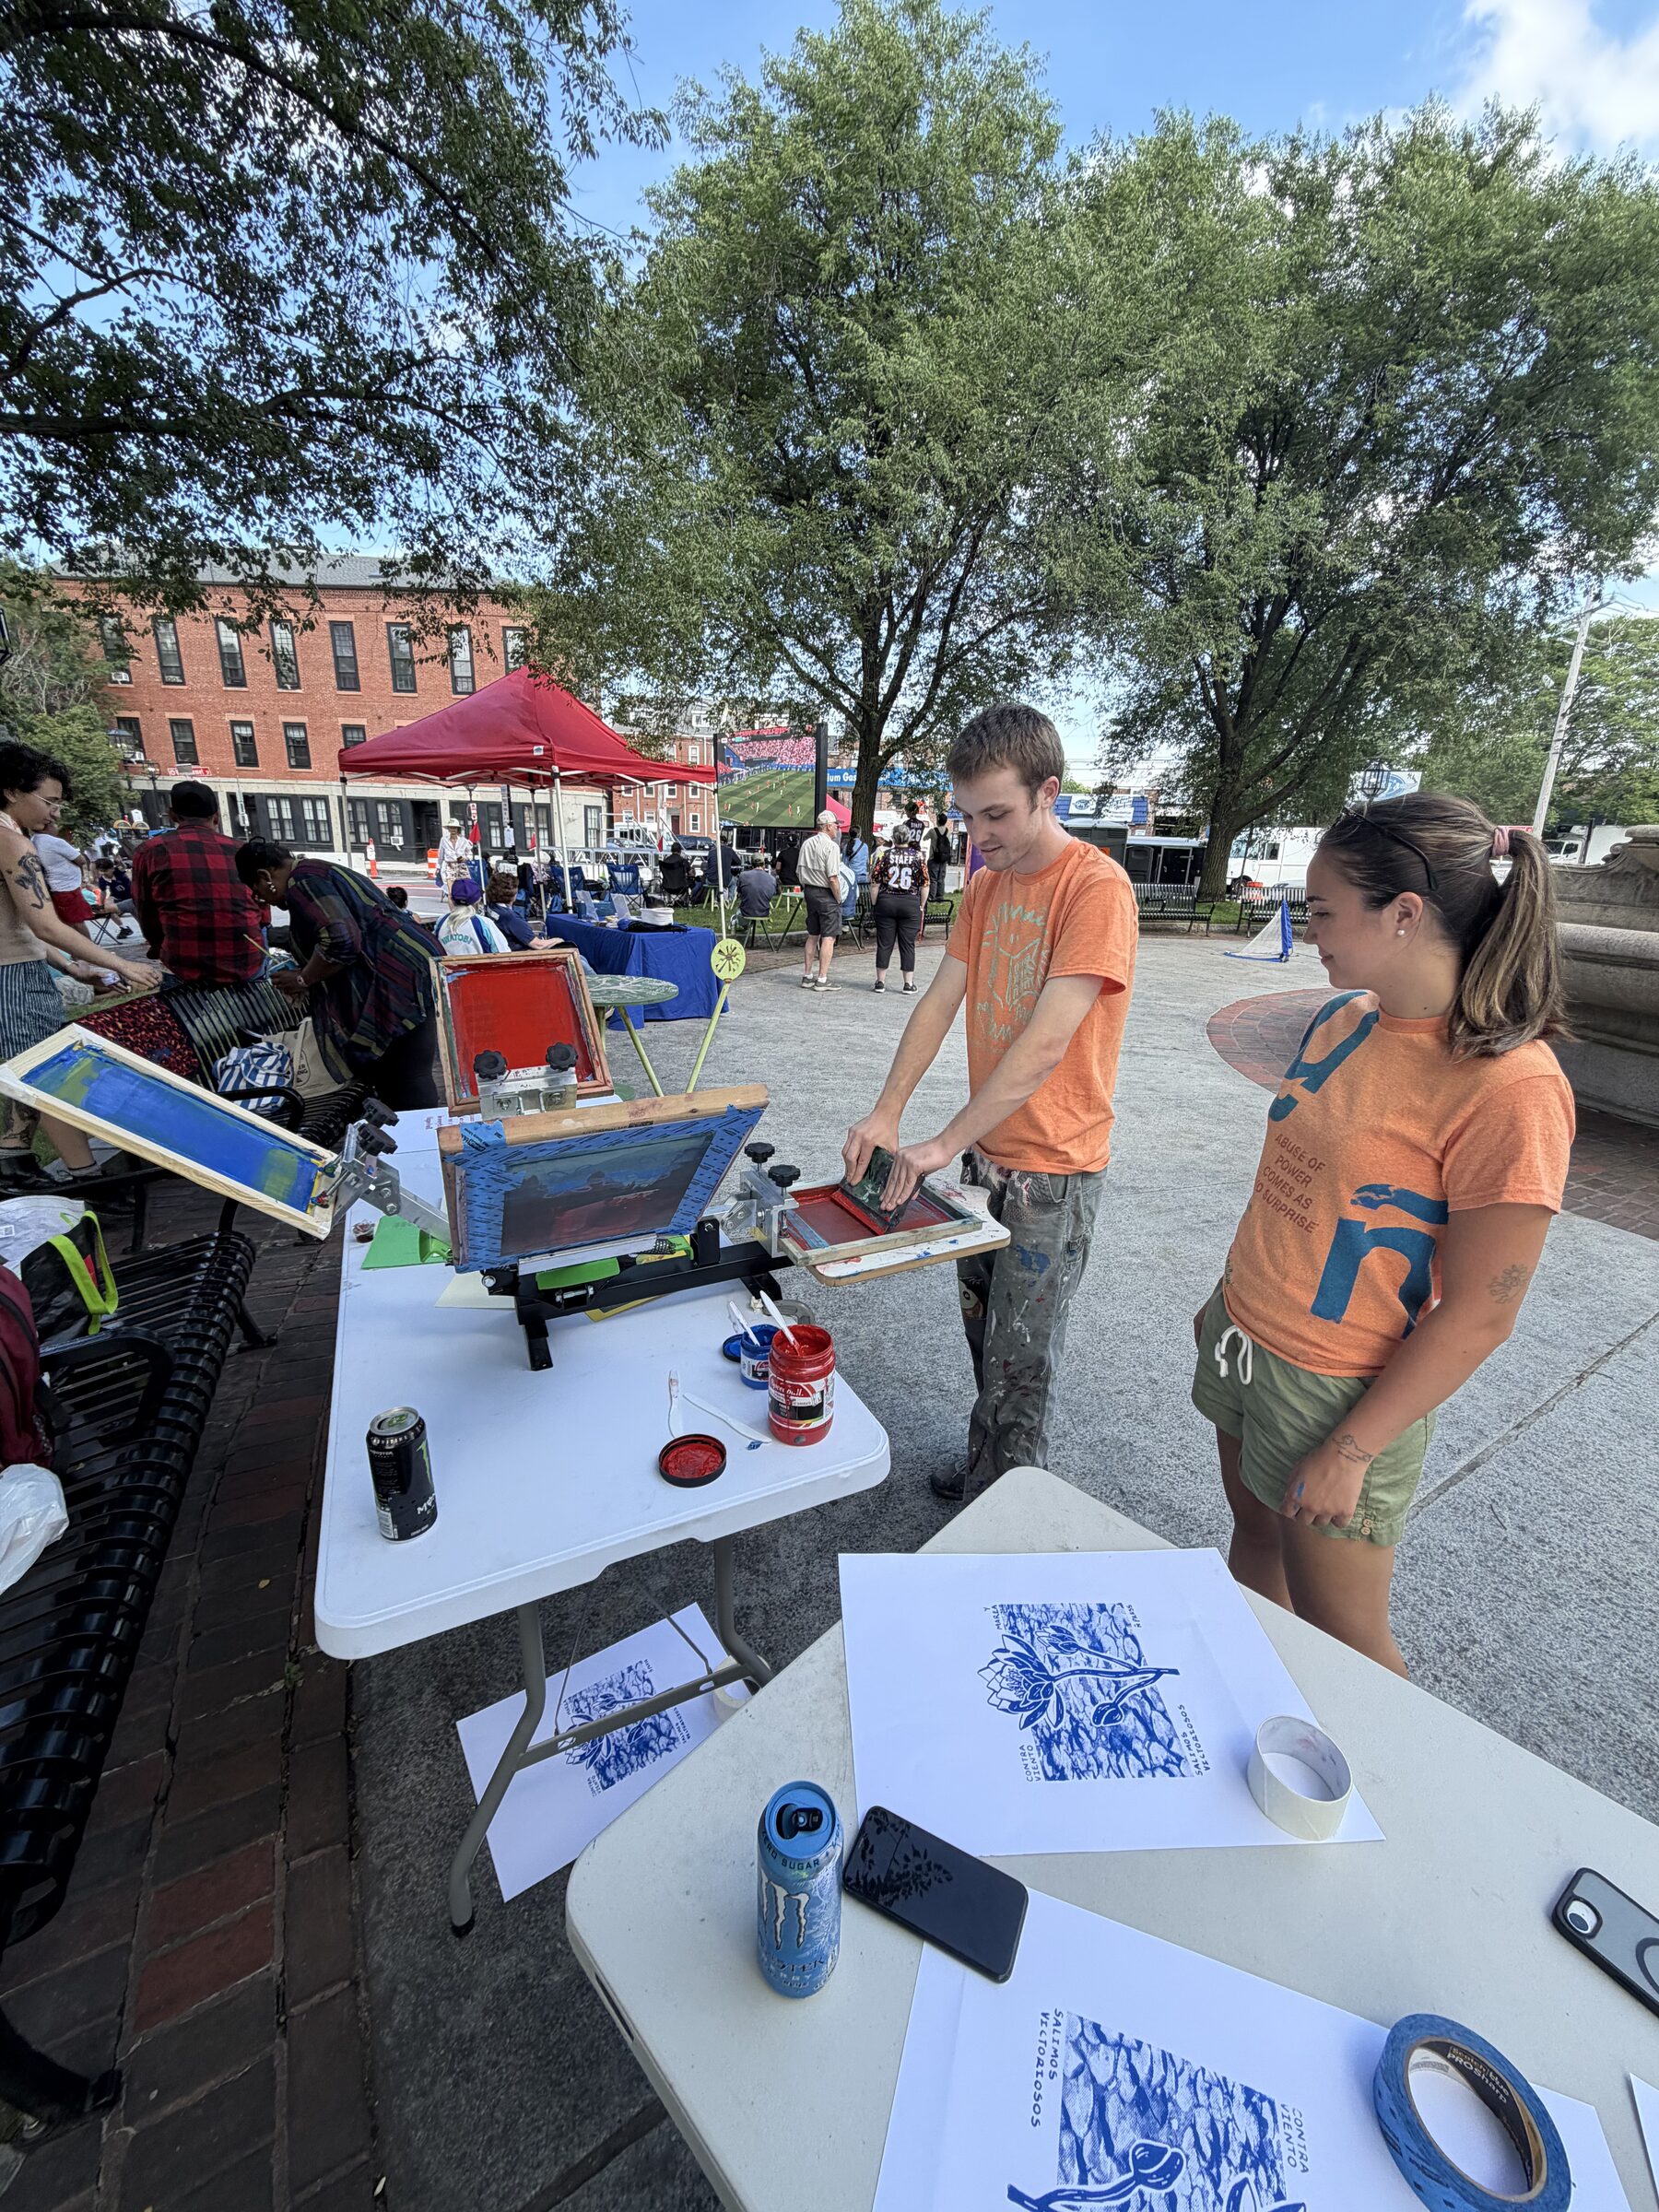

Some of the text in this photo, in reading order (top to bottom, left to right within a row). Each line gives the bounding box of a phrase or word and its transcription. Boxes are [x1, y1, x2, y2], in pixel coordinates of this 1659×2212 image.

[910, 830, 922, 841] 26
[888, 865, 912, 890] 26
[889, 853, 914, 865] STAFF
[1275, 1134, 1325, 1172] ABUSE OF
[1275, 1155, 1312, 1188] POWER
[1263, 1166, 1312, 1209] COMES AS
[1262, 1188, 1319, 1234] SURPRISE
[991, 1604, 1003, 1630] MAREA
[1177, 1704, 1210, 1771] VICTORIOSOS
[1181, 1732, 1203, 1777] SALIMOS
[1019, 1745, 1033, 1782] CONTRA
[1027, 1745, 1041, 1782] VIENTO
[781, 1857, 820, 1871] SUGAR
[1049, 2007, 1064, 2080] SALIMOS
[1030, 2011, 1050, 2128] VICTORIOSOS
[1280, 2103, 1298, 2169] VIENTO
[1292, 2107, 1309, 2173] CONTRA
